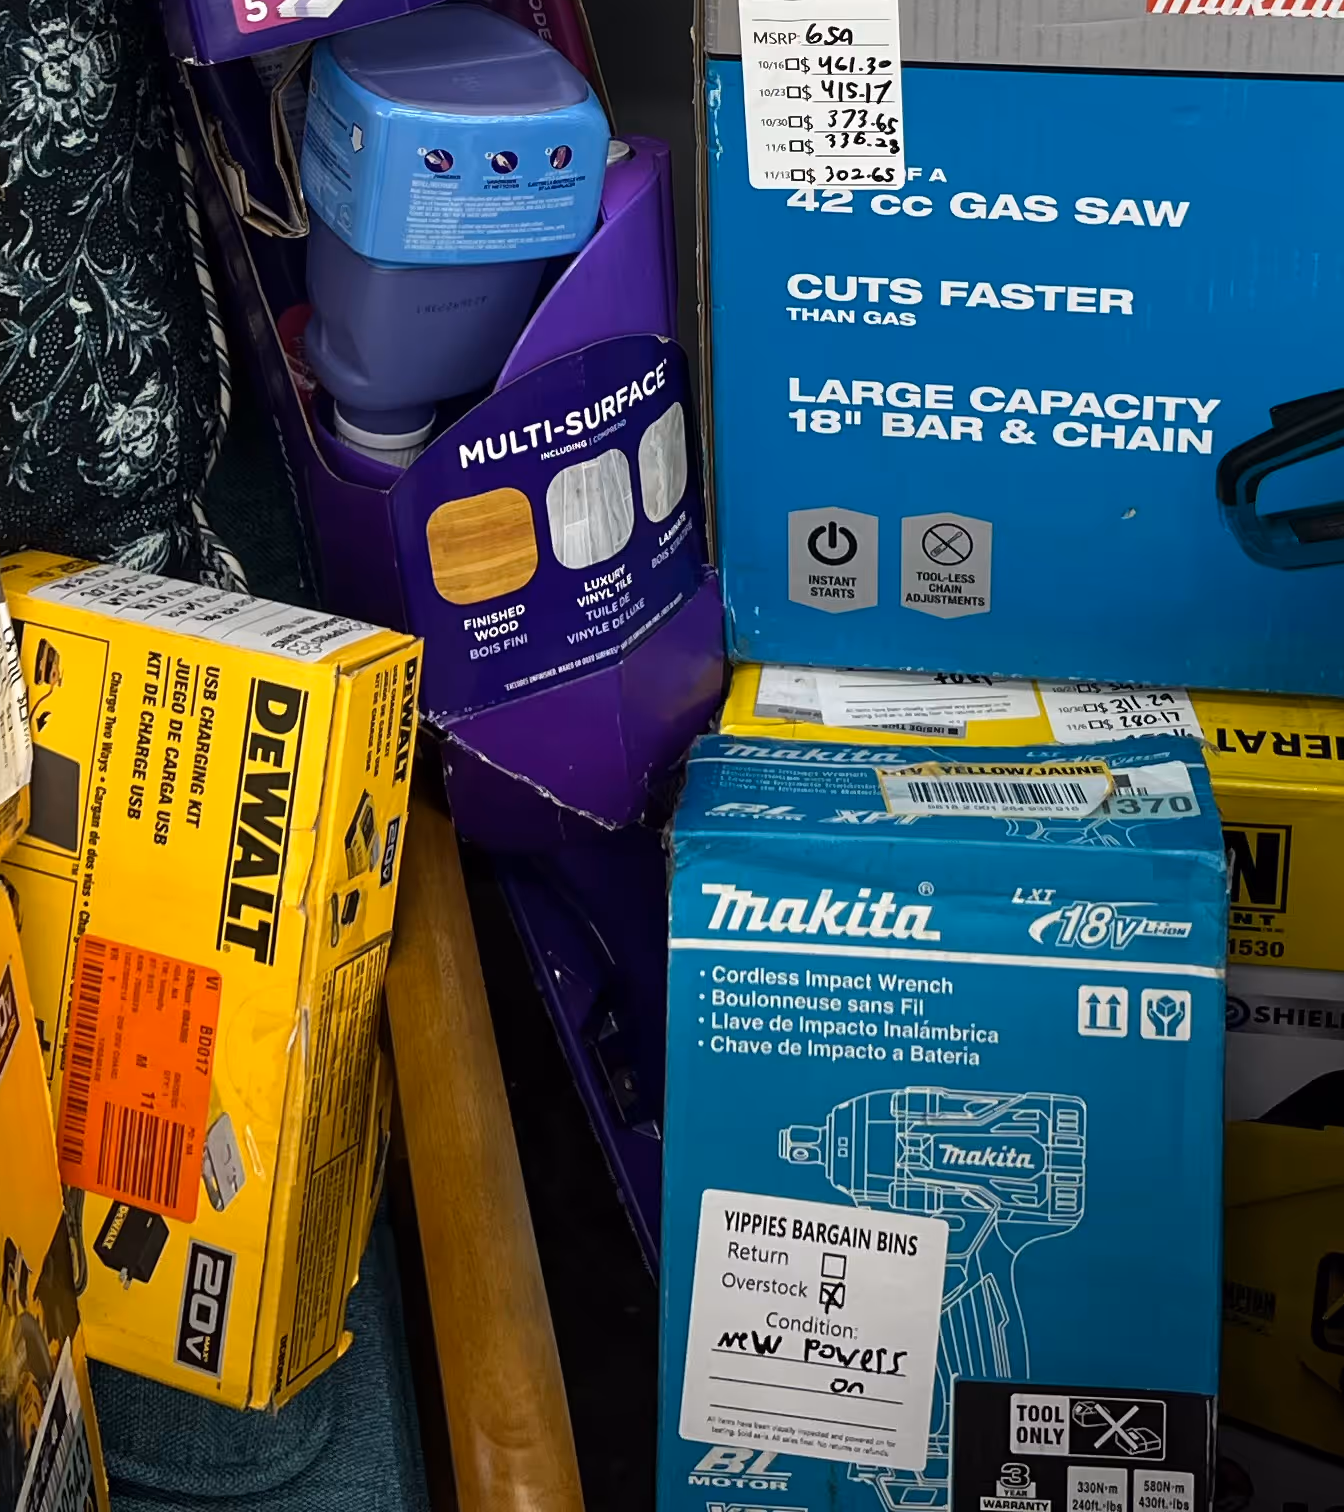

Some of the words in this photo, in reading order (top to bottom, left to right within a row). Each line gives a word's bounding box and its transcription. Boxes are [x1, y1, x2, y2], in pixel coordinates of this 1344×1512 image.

[786, 188, 853, 214] 42
[871, 194, 933, 217] cc
[950, 193, 1058, 223] GAS
[1075, 197, 1189, 228] SAW
[787, 274, 922, 305] CUTS
[941, 281, 1133, 315] FASTER
[787, 307, 855, 324] THAN
[863, 311, 917, 326] GAS
[458, 361, 666, 469] MULTI-SURFACE
[790, 378, 954, 411] LARGE
[970, 386, 1220, 423] CAPACITY
[882, 413, 982, 441] BAR
[1000, 420, 1037, 445] &
[1053, 423, 1213, 454] CHAIN
[808, 575, 857, 588] INSTANT
[810, 587, 855, 600] STARTS
[905, 593, 986, 608] ADJUSTMENTS
[464, 605, 525, 630] FINISHED
[474, 620, 518, 641] WOOD
[204, 666, 220, 701] USB
[190, 706, 215, 795] CHARGING
[186, 799, 202, 829] KIT
[224, 678, 303, 966] DEWALT
[712, 966, 797, 988] Cordless
[805, 970, 873, 994] Impact
[877, 972, 954, 996] Wrench
[712, 988, 842, 1011] Boulonneuse
[849, 997, 895, 1014] sans
[901, 996, 924, 1016] Fil
[1016, 1404, 1064, 1425] TOOL
[1016, 1425, 1064, 1446] ONLY
